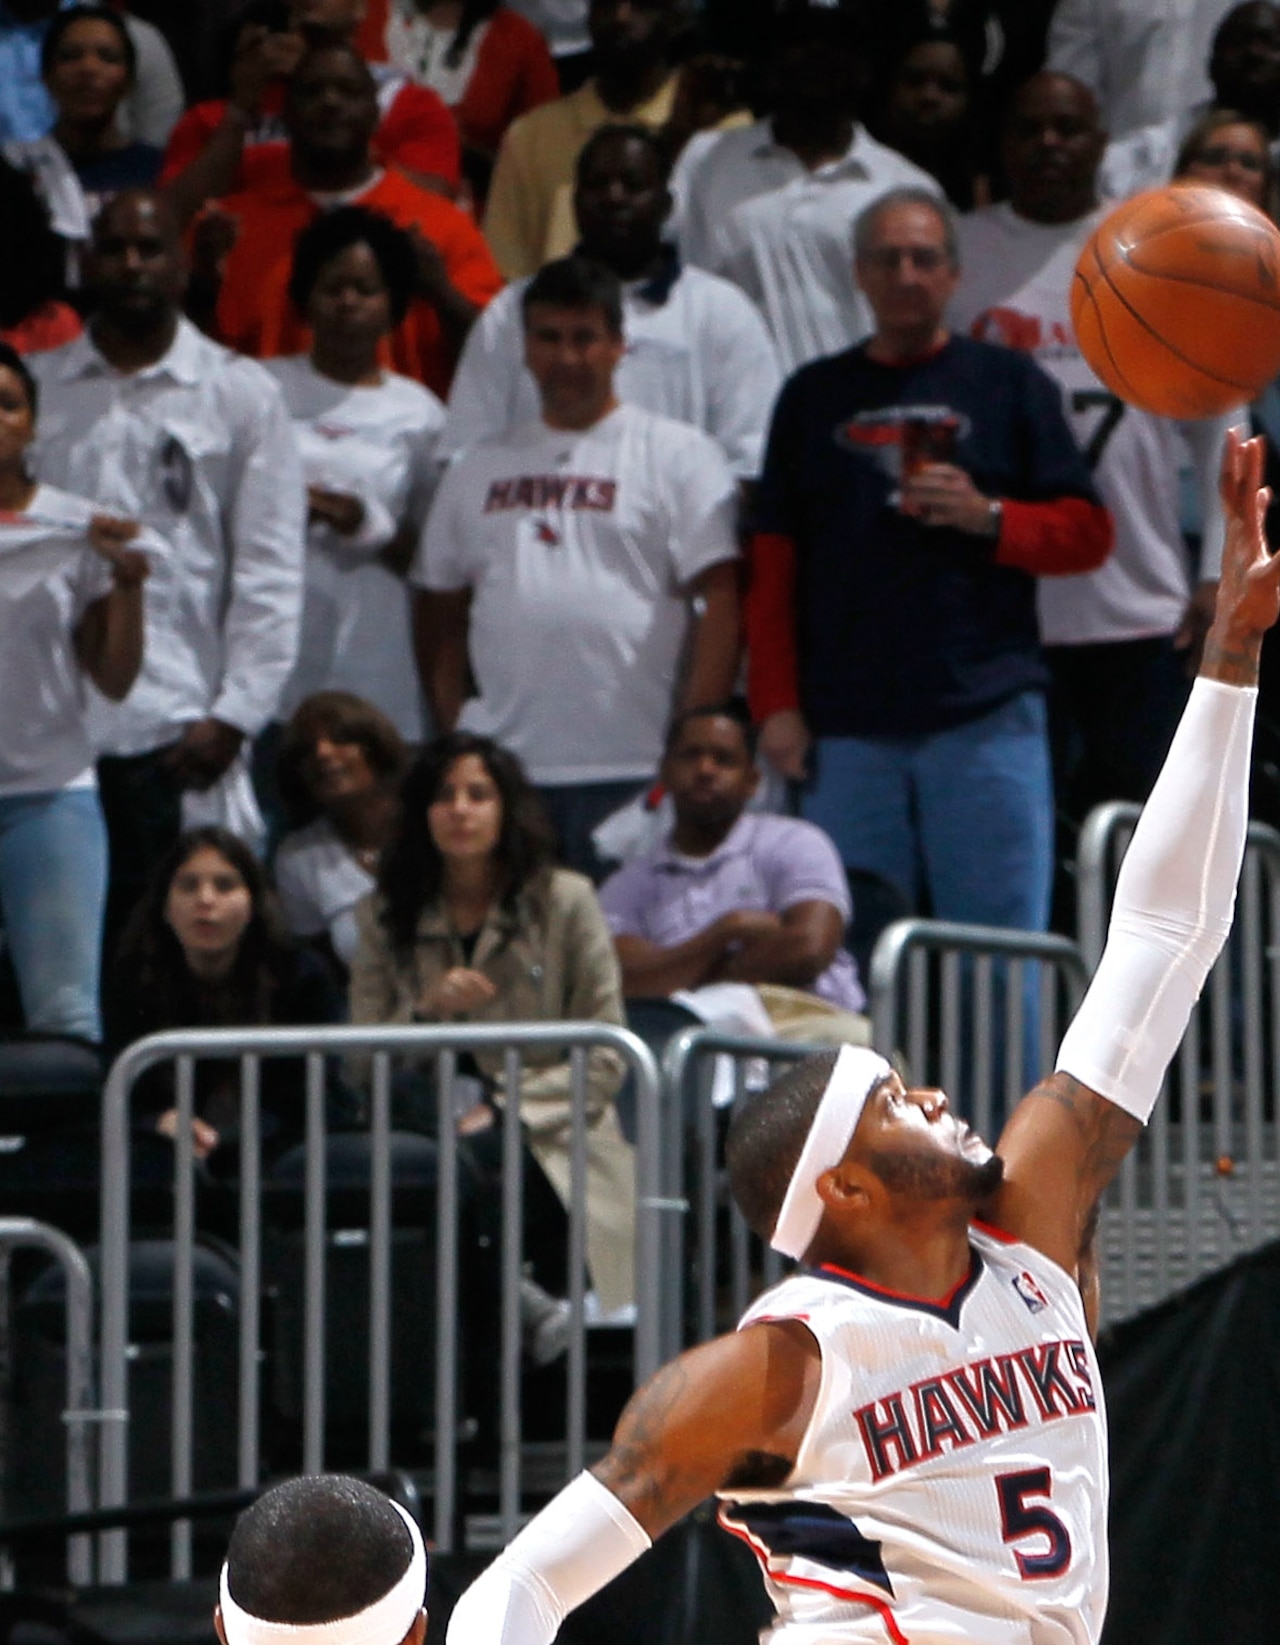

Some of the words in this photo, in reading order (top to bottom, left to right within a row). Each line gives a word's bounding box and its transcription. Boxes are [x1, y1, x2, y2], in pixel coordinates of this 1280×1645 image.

[484, 475, 616, 515] HAWKS
[853, 1340, 1097, 1485] HAWKS
[994, 1466, 1072, 1581] 5
